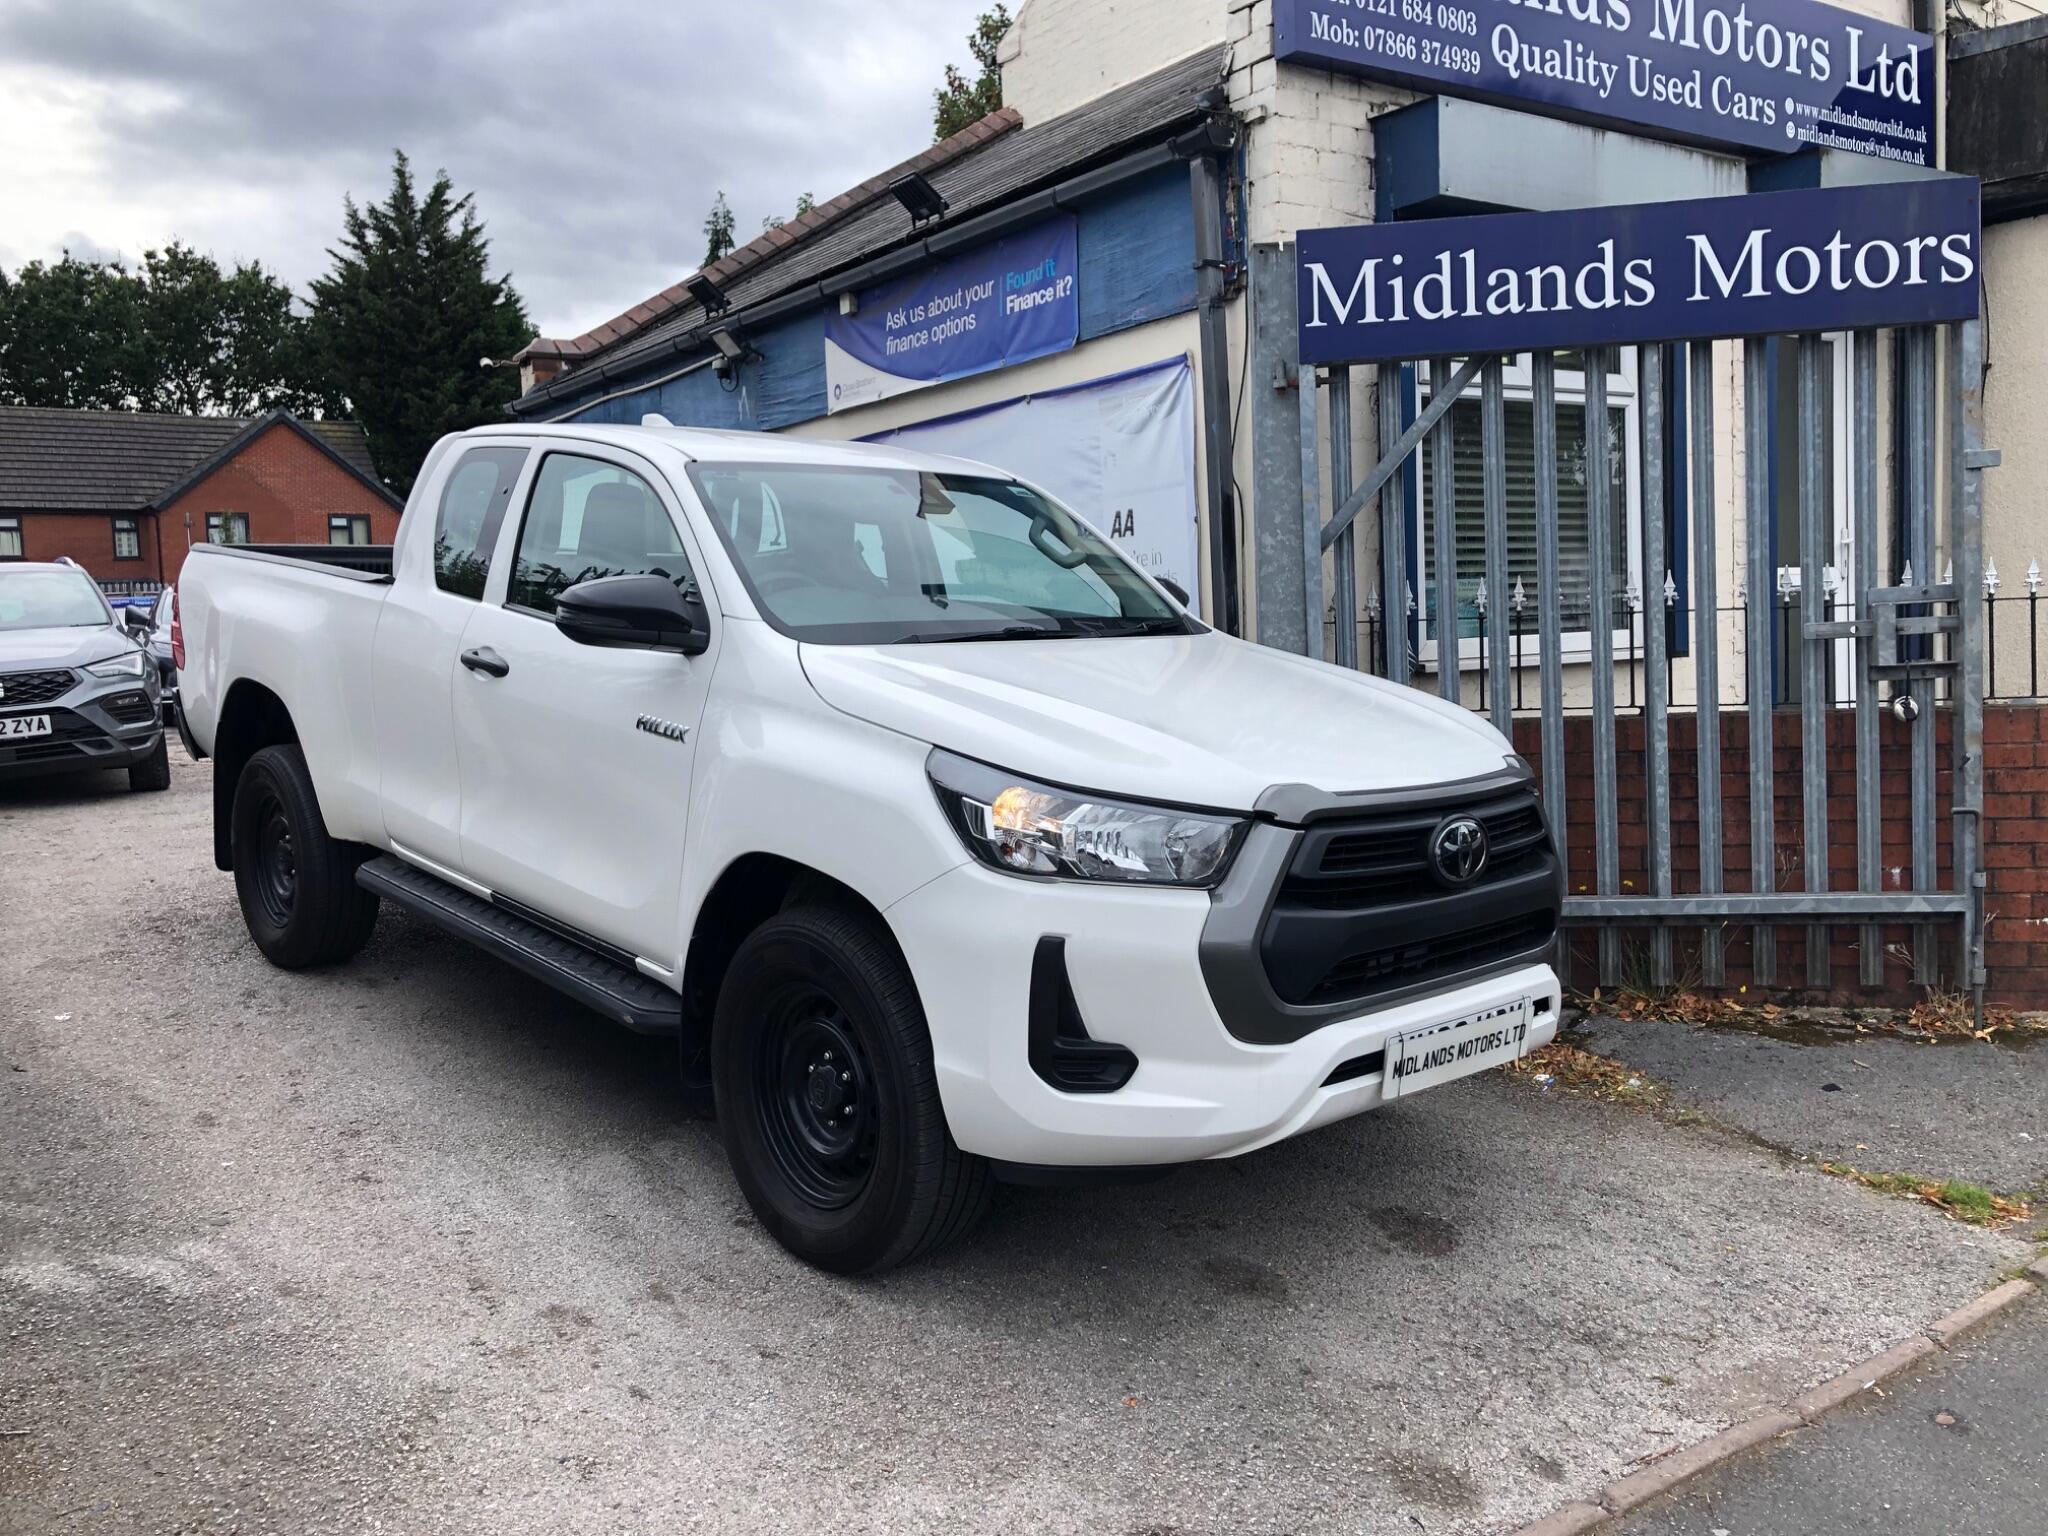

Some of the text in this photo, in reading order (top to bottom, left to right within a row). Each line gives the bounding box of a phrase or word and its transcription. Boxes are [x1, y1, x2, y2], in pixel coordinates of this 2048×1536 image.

[1402, 0, 1433, 26] 684
[1437, 4, 1477, 36] 0803
[1310, 10, 1481, 75] Mob: 07866 374939
[1650, 0, 1921, 105] Motors Ltd
[1491, 23, 1776, 125] Quality Used Cars
[1795, 101, 1928, 144] www.midlandsmotorsltd.co.uk
[1797, 124, 1926, 166] midlandsmotors@yahoo.co.uk
[1006, 257, 1056, 292] Found it
[1006, 274, 1073, 315] Finance it?
[1304, 228, 1975, 329] Midlands Motors
[886, 279, 995, 332] Ask us about your
[886, 313, 977, 356] finance options
[1110, 508, 1135, 539] AA
[11, 717, 47, 734] ZYA
[1392, 1023, 1527, 1079] MIDLANDS MOTORS LTD
